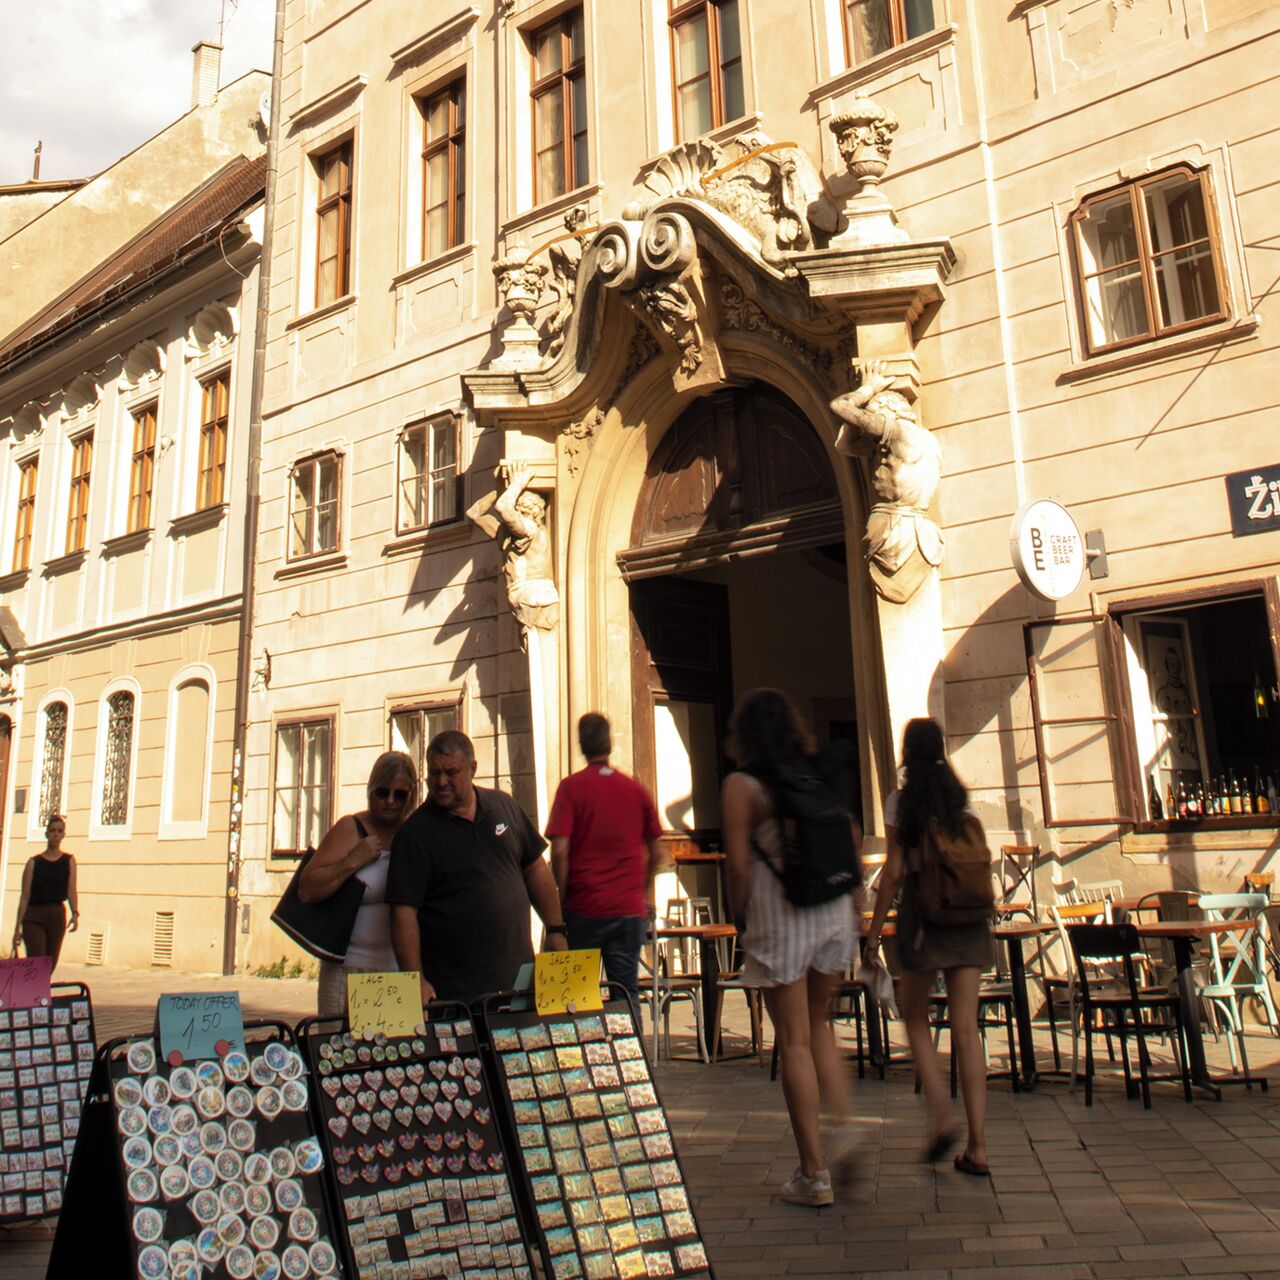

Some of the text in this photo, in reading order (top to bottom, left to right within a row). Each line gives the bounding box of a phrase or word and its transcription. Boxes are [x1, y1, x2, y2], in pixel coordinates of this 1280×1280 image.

[1050, 535, 1077, 545] CRAFT
[1052, 545, 1074, 555] BEER
[1054, 555, 1071, 566] BAR
[170, 995, 239, 1010] TODAY OFFER
[200, 1011, 222, 1033] 50
